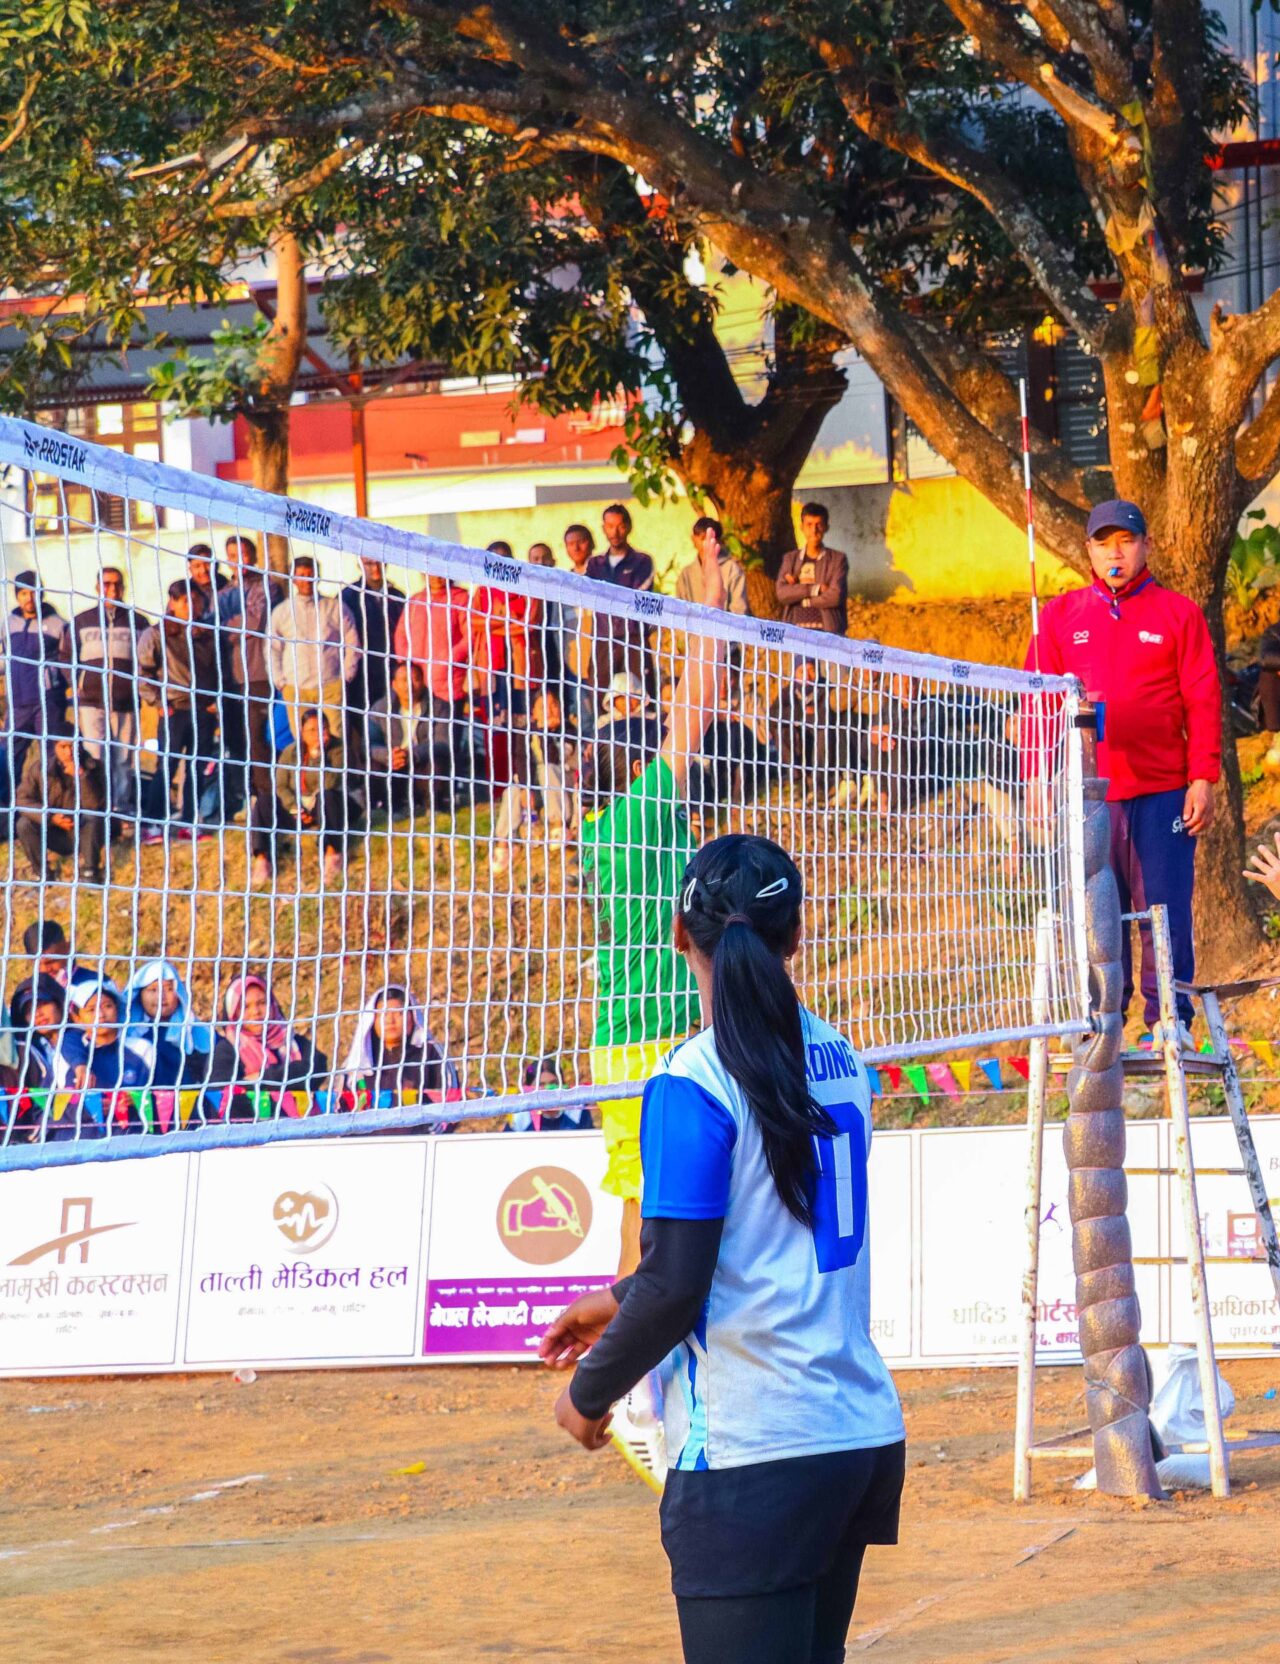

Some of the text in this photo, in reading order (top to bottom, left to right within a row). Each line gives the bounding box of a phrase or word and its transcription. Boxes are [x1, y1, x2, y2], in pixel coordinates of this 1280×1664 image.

[39, 438, 88, 473] PROSTAR
[296, 508, 331, 537] PROSTAR
[804, 1040, 858, 1084] DING
[271, 1261, 361, 1289] मेडिकल
[1210, 1295, 1279, 1317] अधिकार
